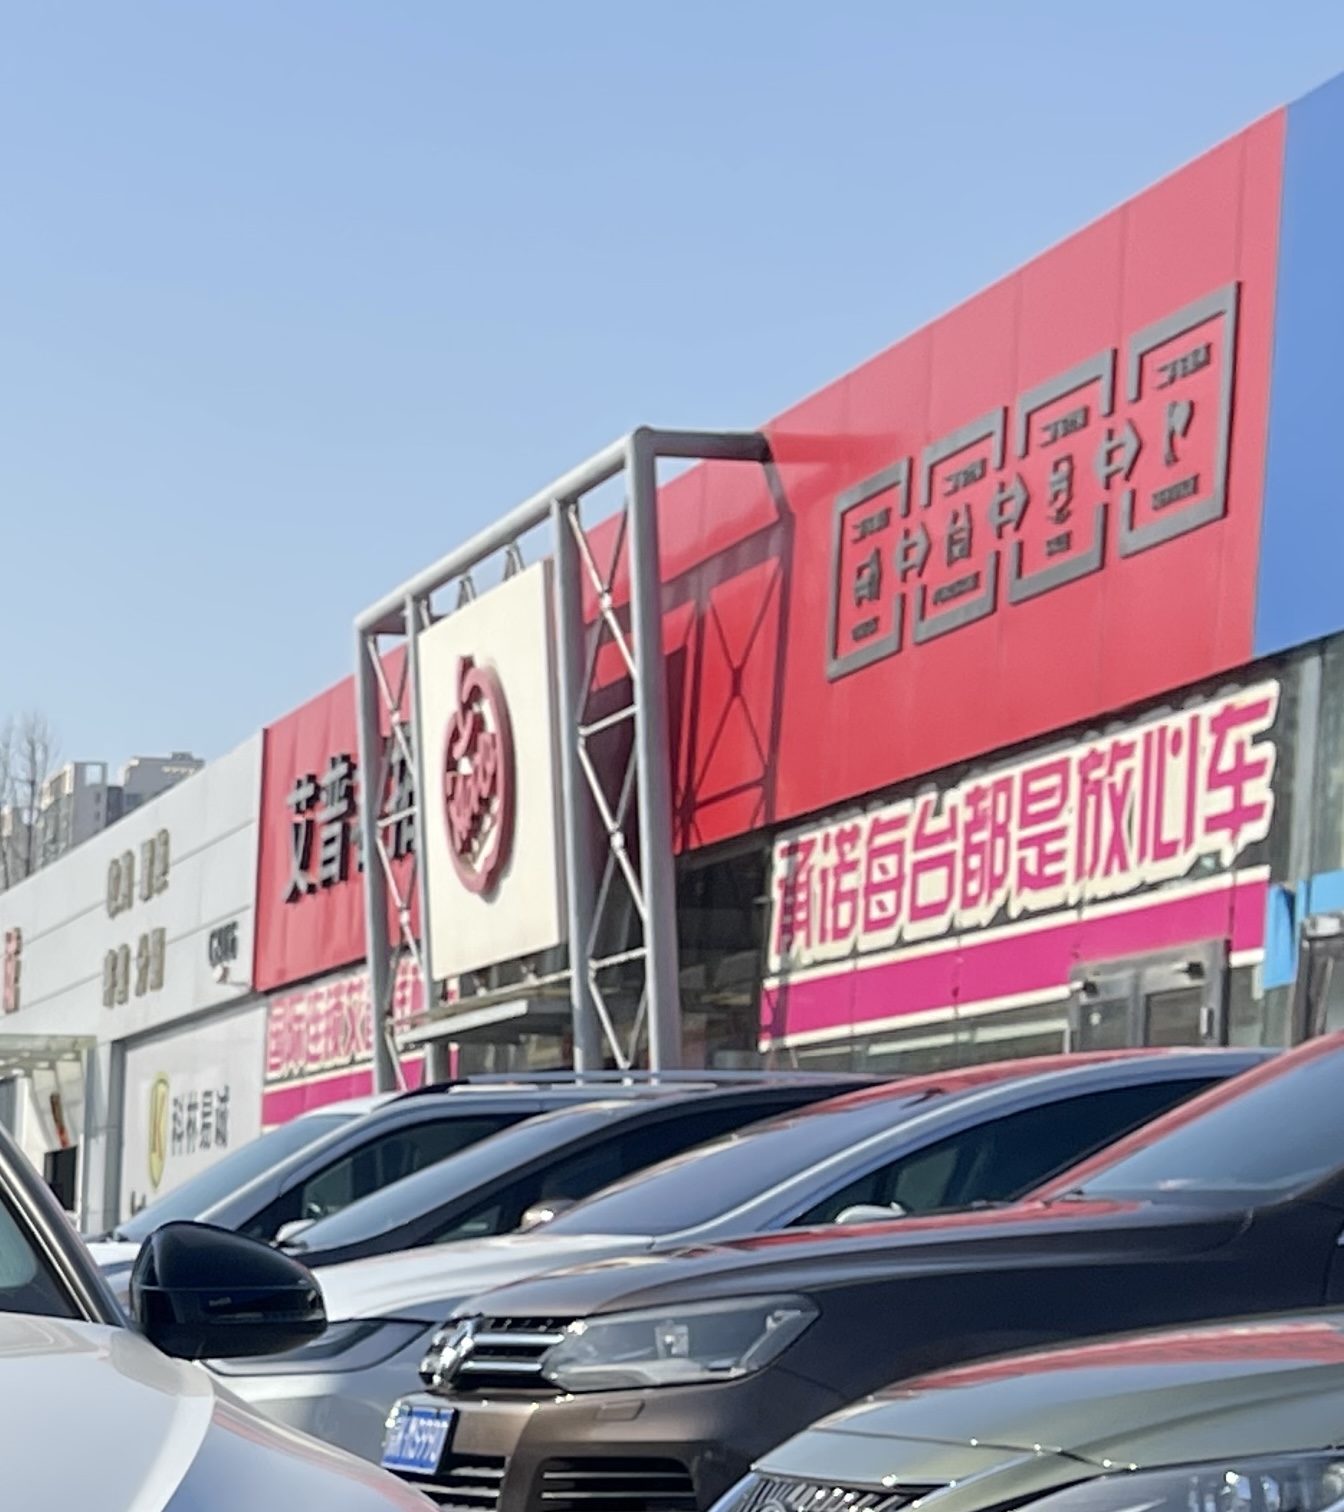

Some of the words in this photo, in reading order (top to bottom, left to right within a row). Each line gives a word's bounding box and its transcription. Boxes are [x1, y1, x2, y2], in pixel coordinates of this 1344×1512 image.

[772, 695, 1274, 955] 承诺每台都是放心车
